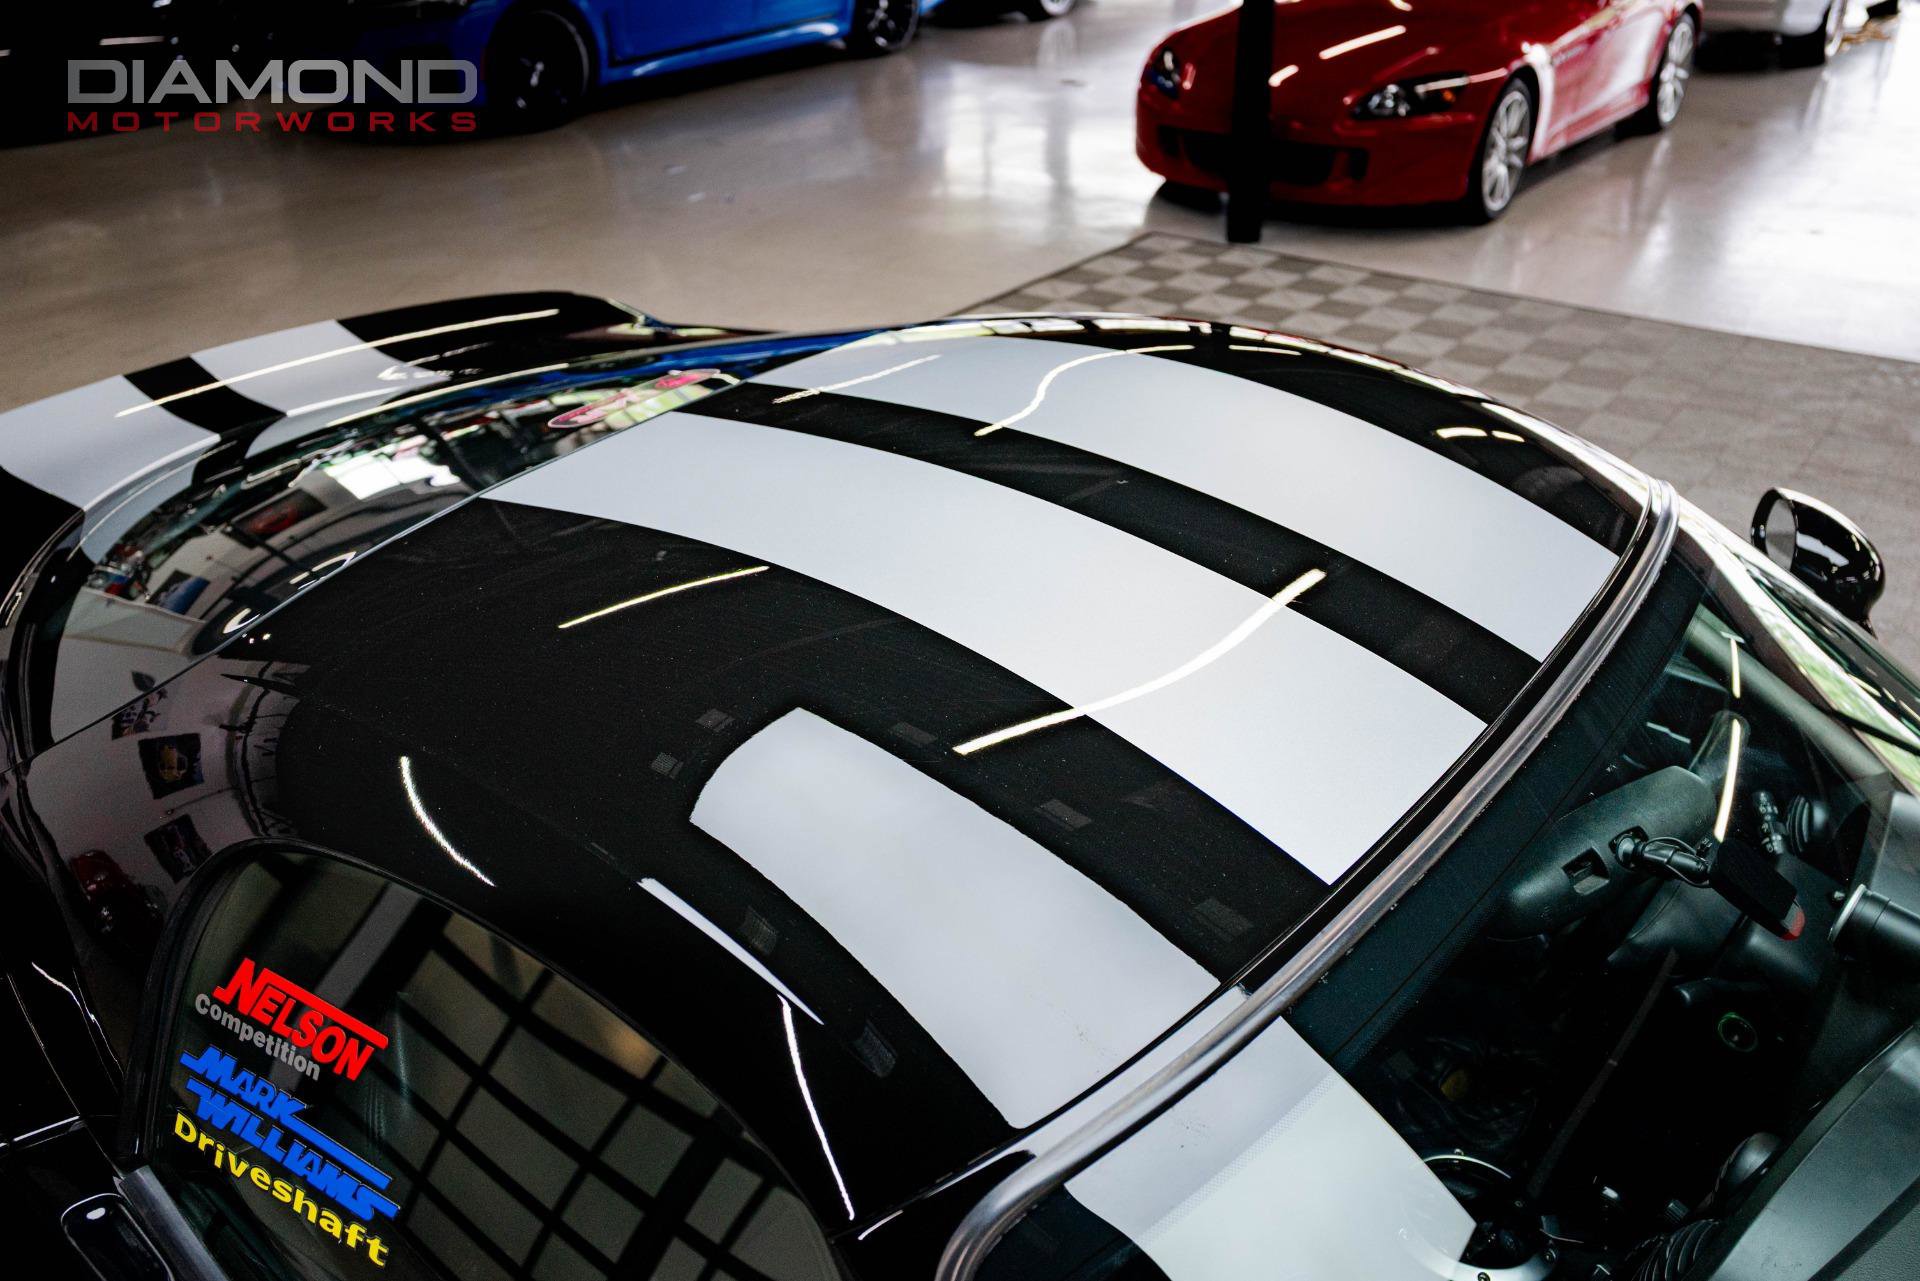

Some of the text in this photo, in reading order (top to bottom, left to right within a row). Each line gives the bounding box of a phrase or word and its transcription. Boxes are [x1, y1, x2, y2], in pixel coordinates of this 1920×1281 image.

[195, 993, 320, 1081] Competition
[212, 957, 388, 1081] NELSON
[174, 1112, 389, 1267] Driveshaft
[180, 1045, 392, 1190] MARK
[186, 1077, 400, 1221] WILLIAMS
